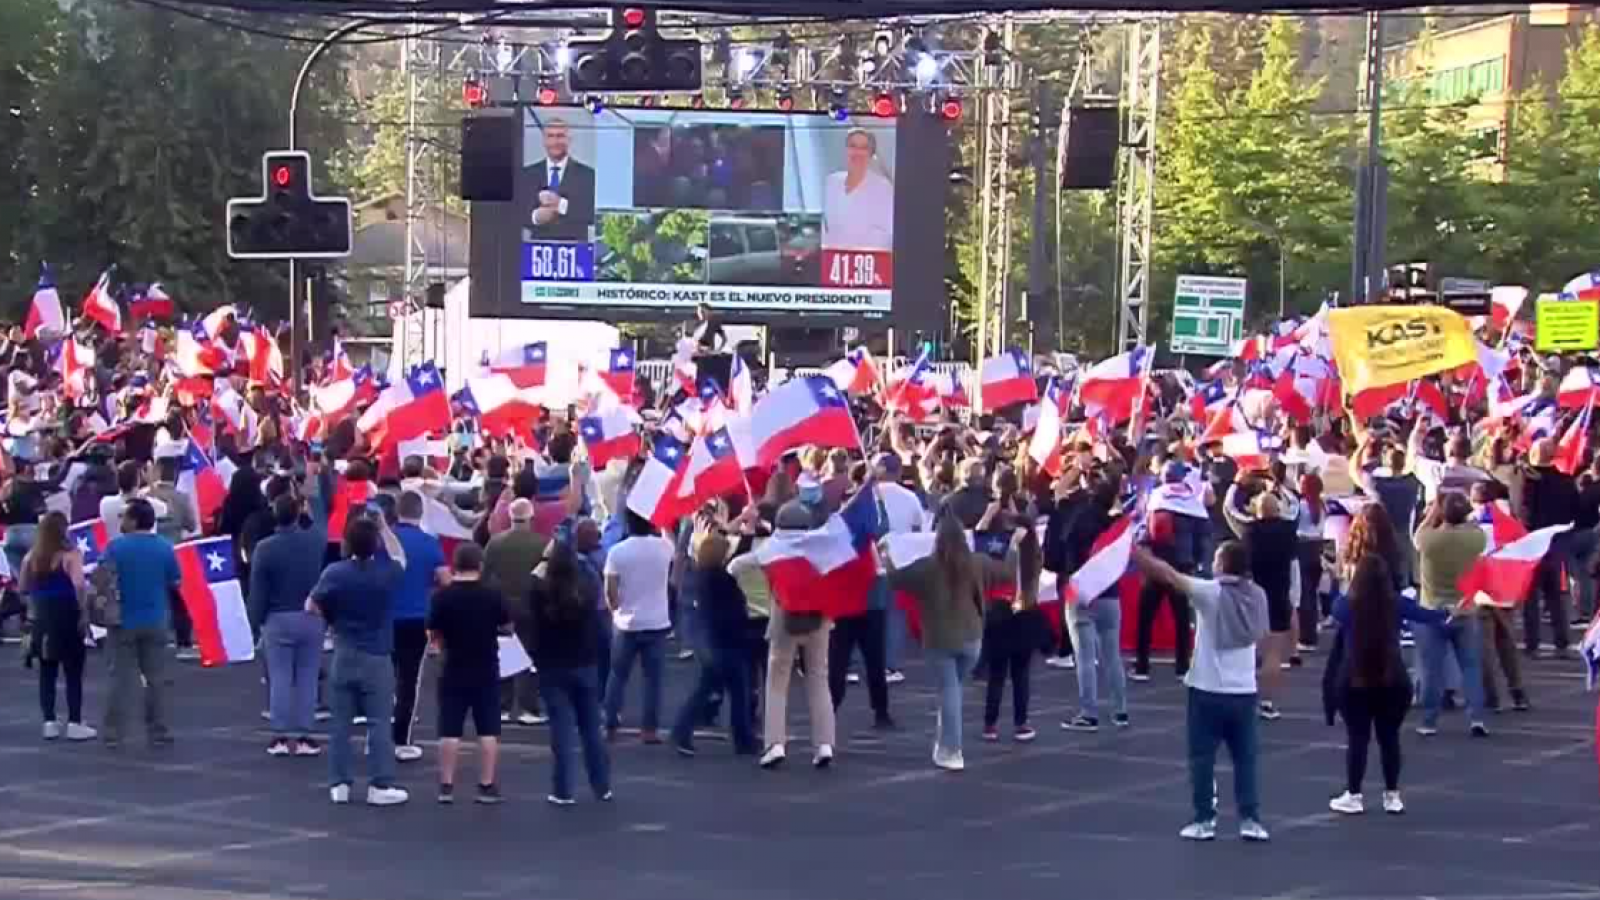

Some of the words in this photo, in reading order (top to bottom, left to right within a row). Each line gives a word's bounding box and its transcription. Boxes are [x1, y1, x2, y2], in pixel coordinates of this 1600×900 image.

[597, 287, 671, 301] HISTÓRICO:
[673, 291, 706, 302] KAST
[708, 292, 726, 302] ES
[728, 293, 744, 302] EL
[747, 293, 792, 303] NUEVO
[795, 294, 873, 304] PRESIDENTE
